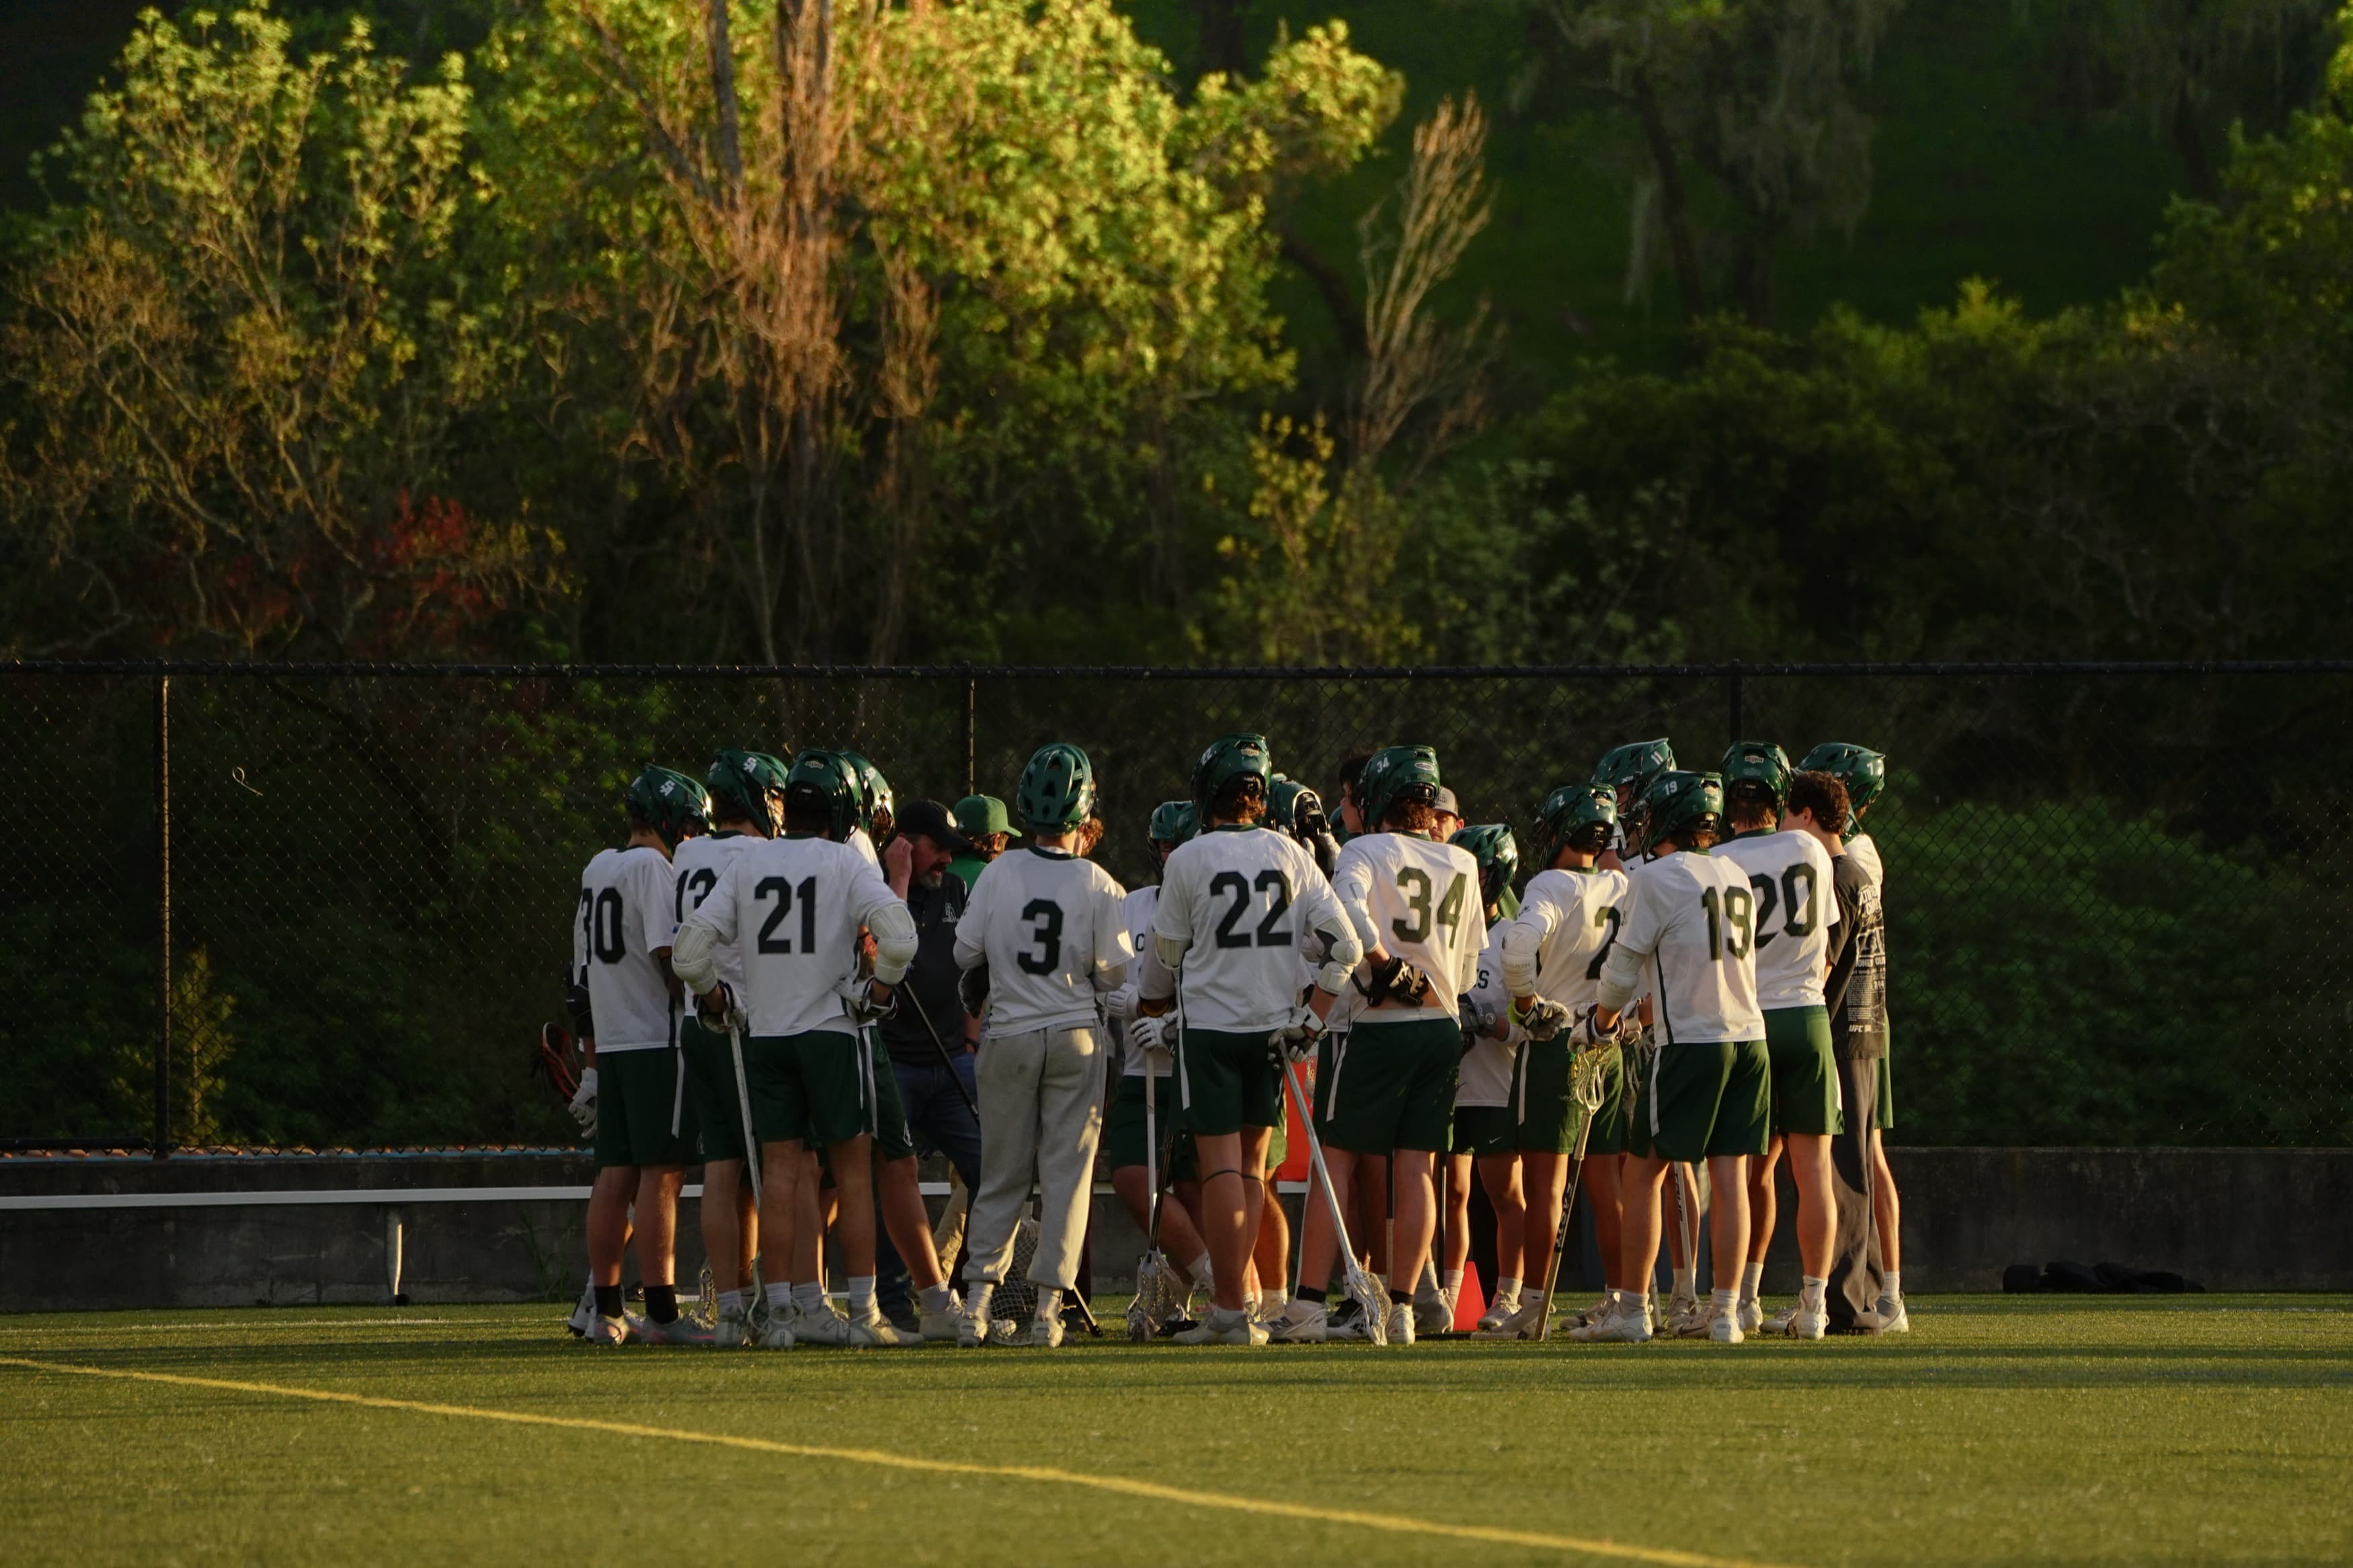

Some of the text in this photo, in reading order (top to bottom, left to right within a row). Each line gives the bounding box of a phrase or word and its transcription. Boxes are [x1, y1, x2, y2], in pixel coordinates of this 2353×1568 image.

[1376, 757, 1390, 773] 34
[1651, 751, 1663, 765] 11
[1665, 781, 1677, 796] 19
[1557, 794, 1565, 807] 2
[754, 876, 816, 954] 21
[1017, 899, 1064, 977] 3
[1210, 870, 1293, 948] 22
[1392, 866, 1467, 949] 34
[1702, 886, 1753, 961] 19
[1750, 862, 1816, 948] 20
[1849, 1024, 1864, 1032] UFC
